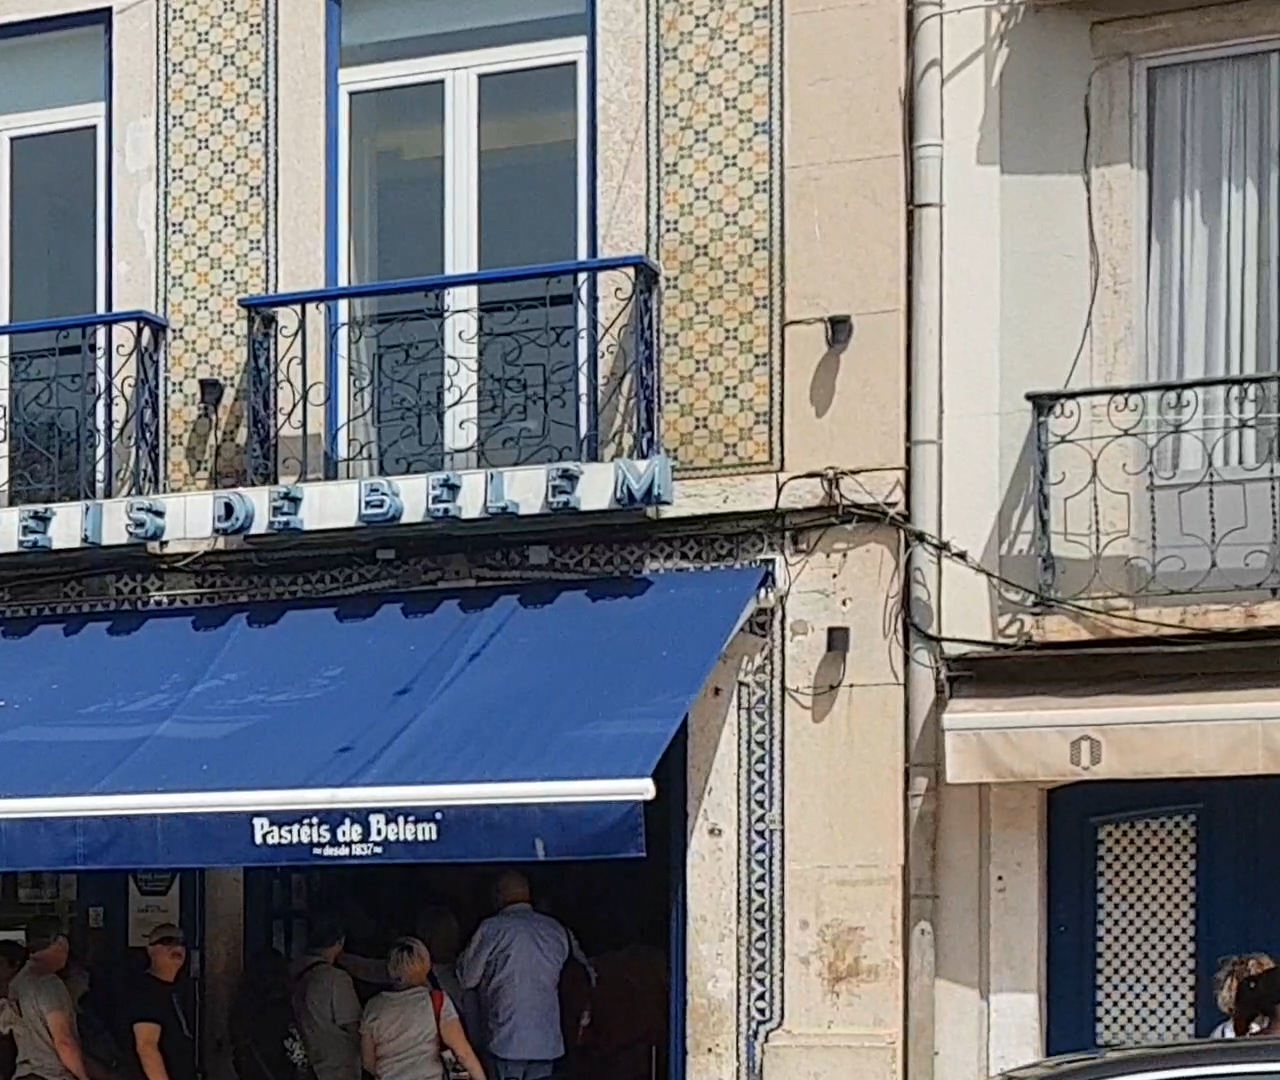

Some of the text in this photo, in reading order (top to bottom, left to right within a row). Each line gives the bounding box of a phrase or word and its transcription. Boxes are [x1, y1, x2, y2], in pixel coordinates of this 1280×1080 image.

[212, 484, 304, 534] DE
[358, 457, 673, 523] BELEM
[252, 813, 438, 845] Pastéis de Belém
